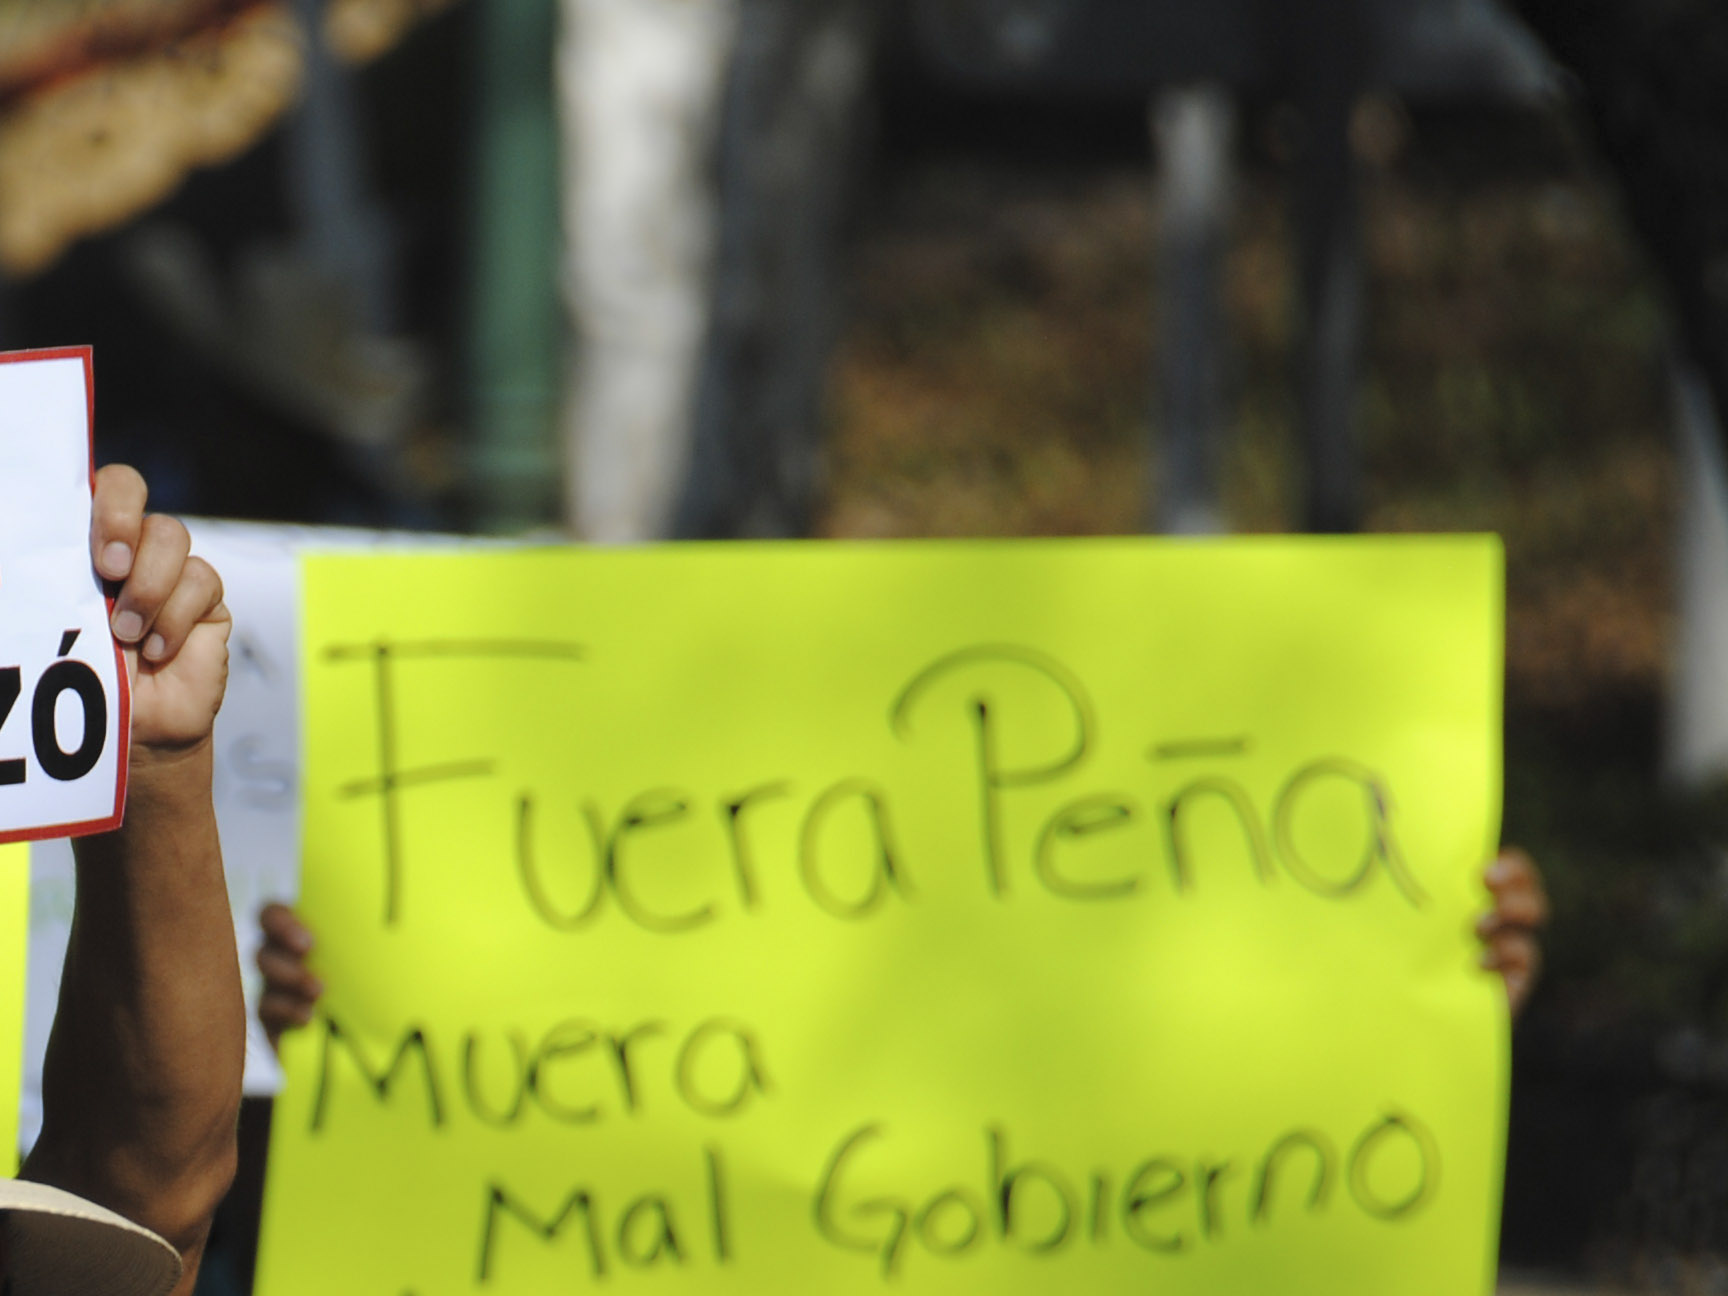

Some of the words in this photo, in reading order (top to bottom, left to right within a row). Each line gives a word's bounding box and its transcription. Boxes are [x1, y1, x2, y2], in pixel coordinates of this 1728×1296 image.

[320, 638, 916, 932] Fuera
[888, 640, 1430, 910] Peña
[308, 1012, 774, 1137] Muera
[472, 1144, 736, 1285] Mal
[808, 1104, 1444, 1278] Gobierno
